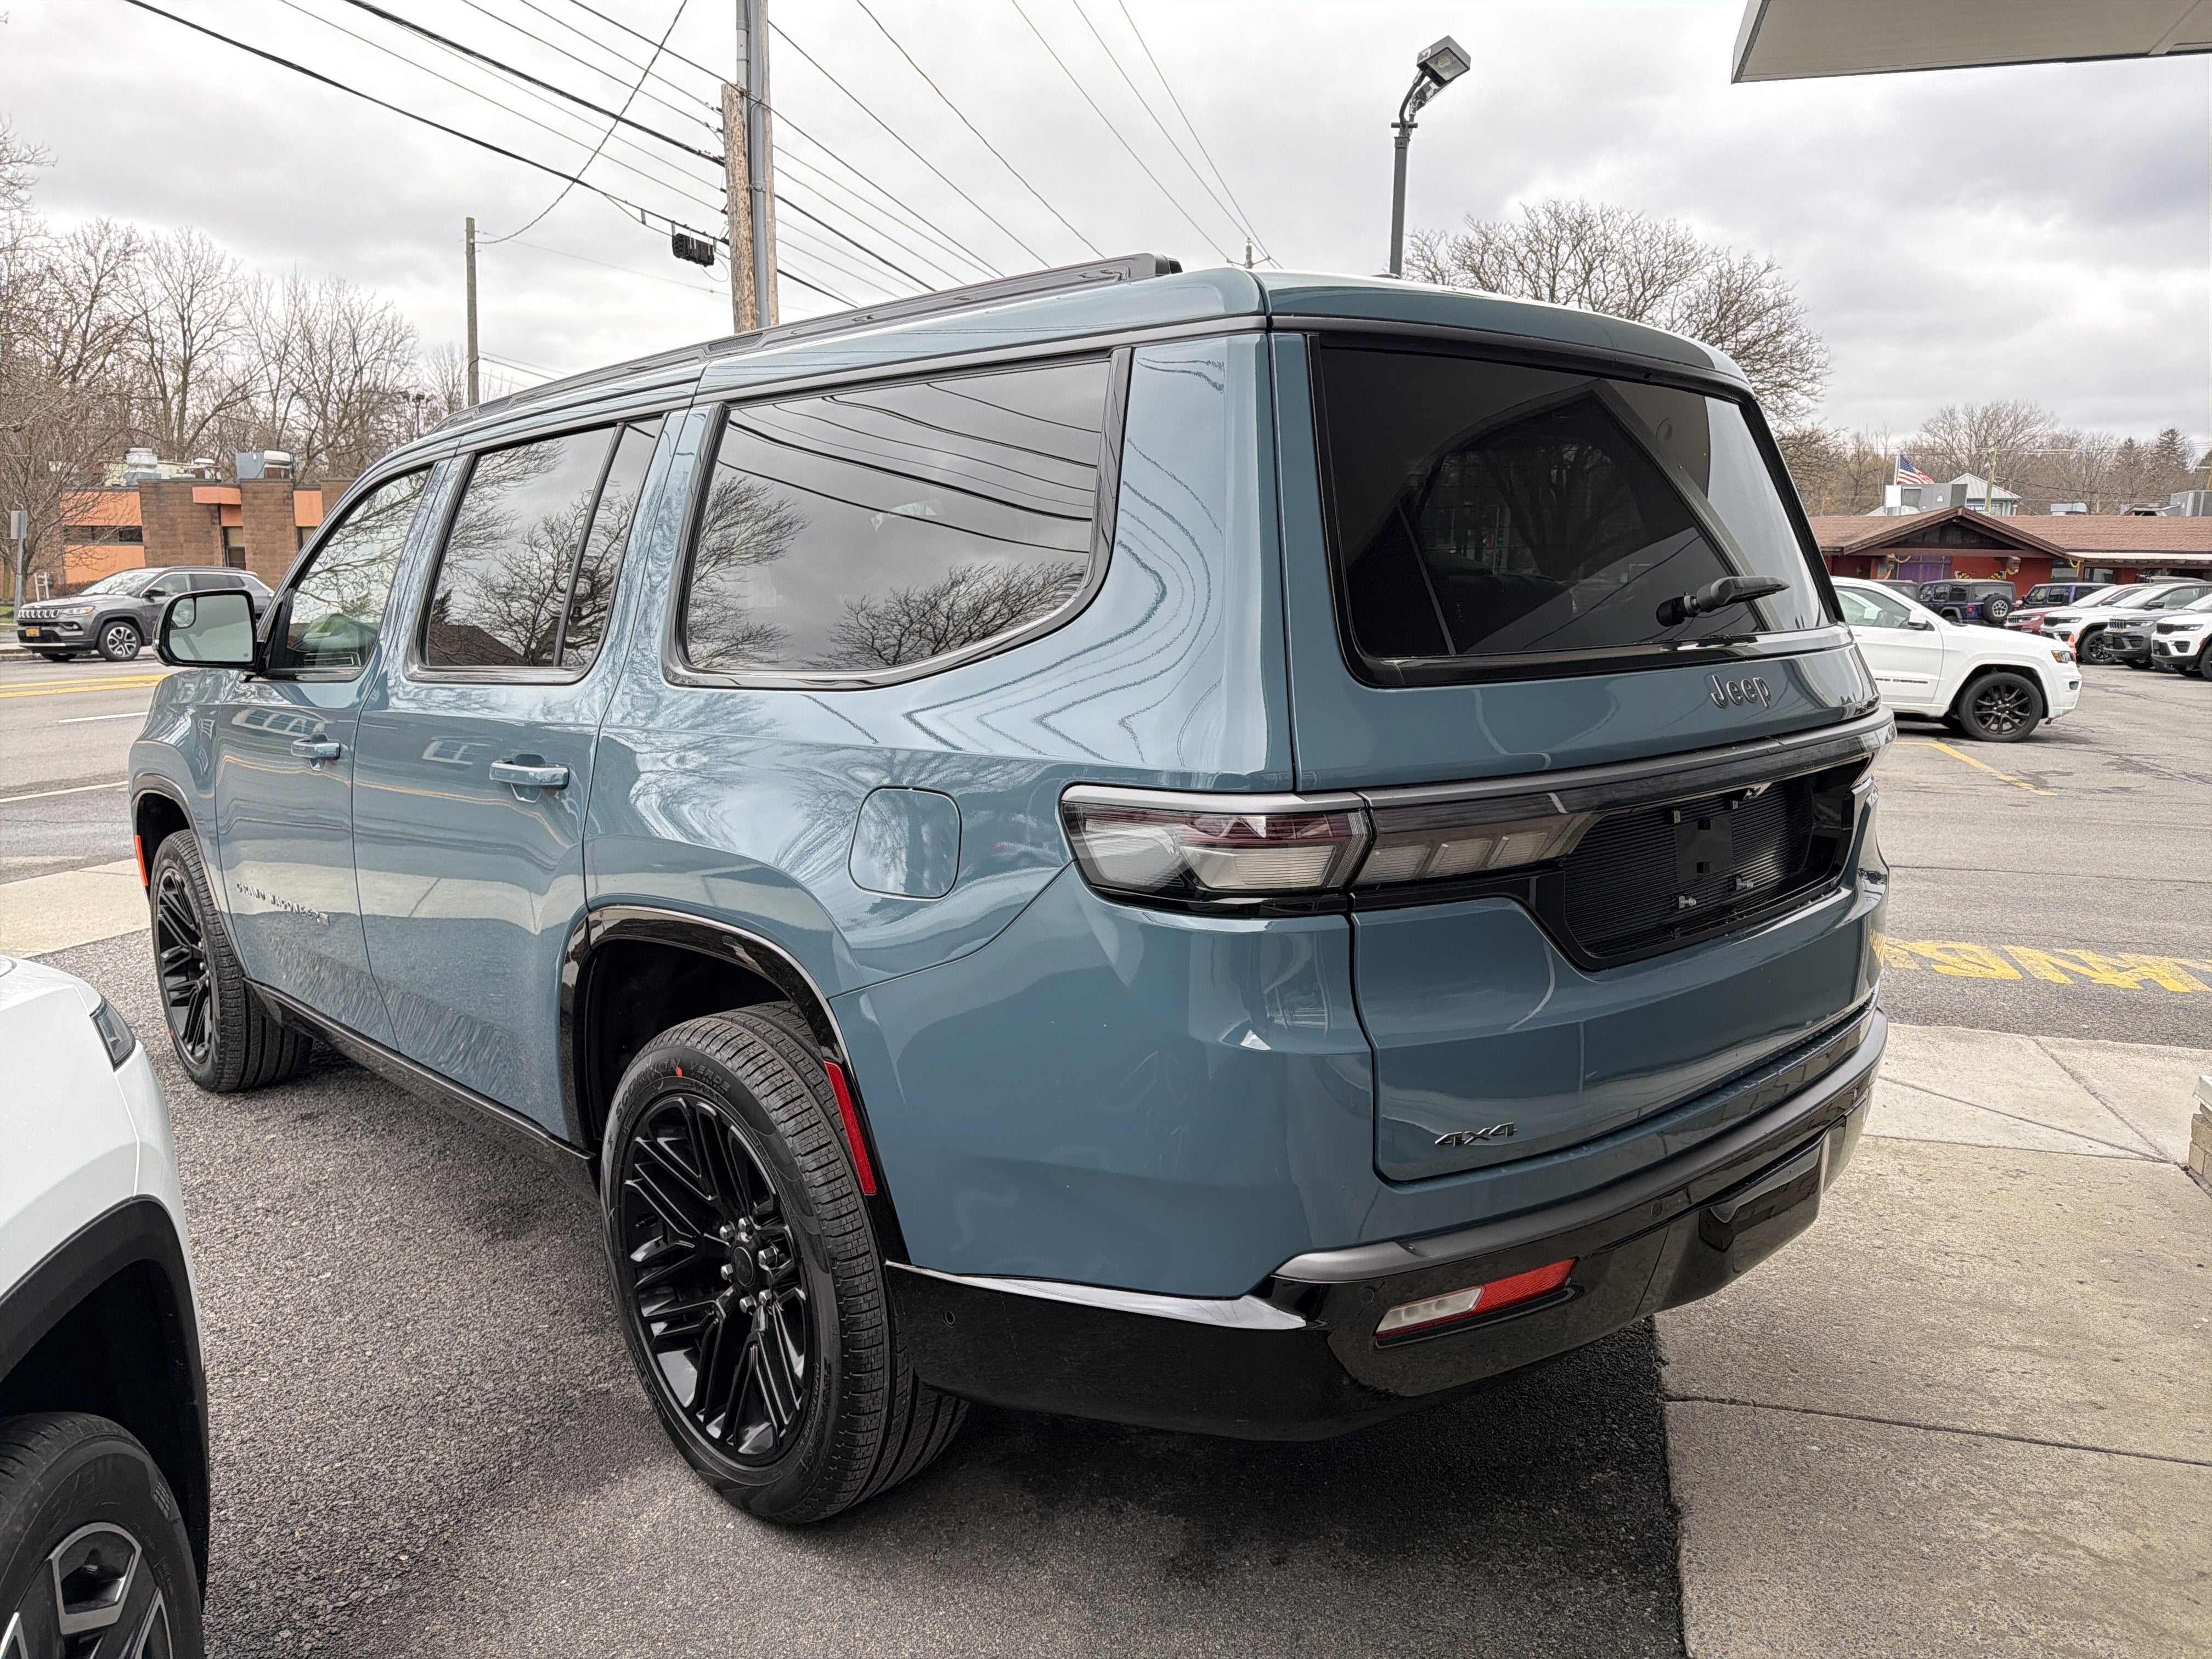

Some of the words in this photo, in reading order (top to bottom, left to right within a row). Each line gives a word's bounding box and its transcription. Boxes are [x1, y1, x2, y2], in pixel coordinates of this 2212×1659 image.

[1711, 675, 1771, 708] Jeep
[616, 1058, 681, 1121] SCORPION
[689, 1061, 731, 1092] VERDE
